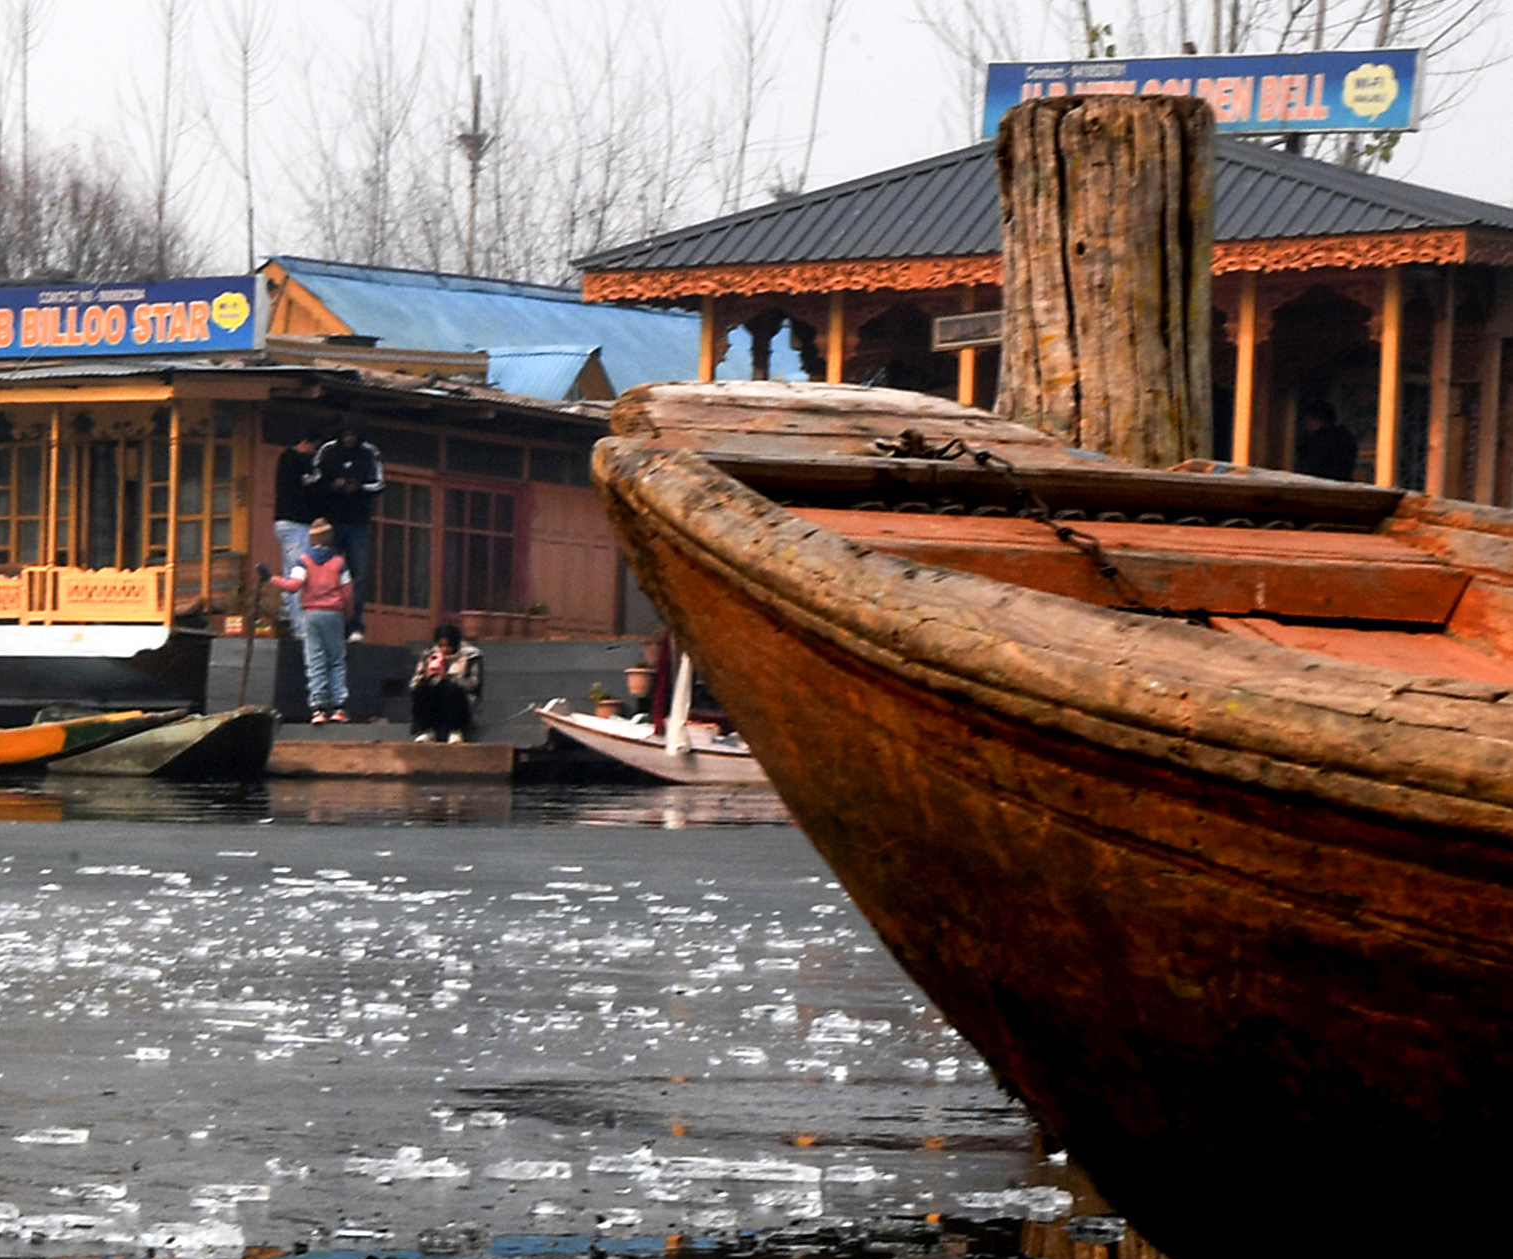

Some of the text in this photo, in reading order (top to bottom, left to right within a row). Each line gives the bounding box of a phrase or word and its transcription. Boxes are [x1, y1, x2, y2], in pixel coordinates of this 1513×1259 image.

[1140, 73, 1329, 123] DEN BELL
[21, 304, 127, 348] BILLOO
[132, 301, 210, 344] STAR
